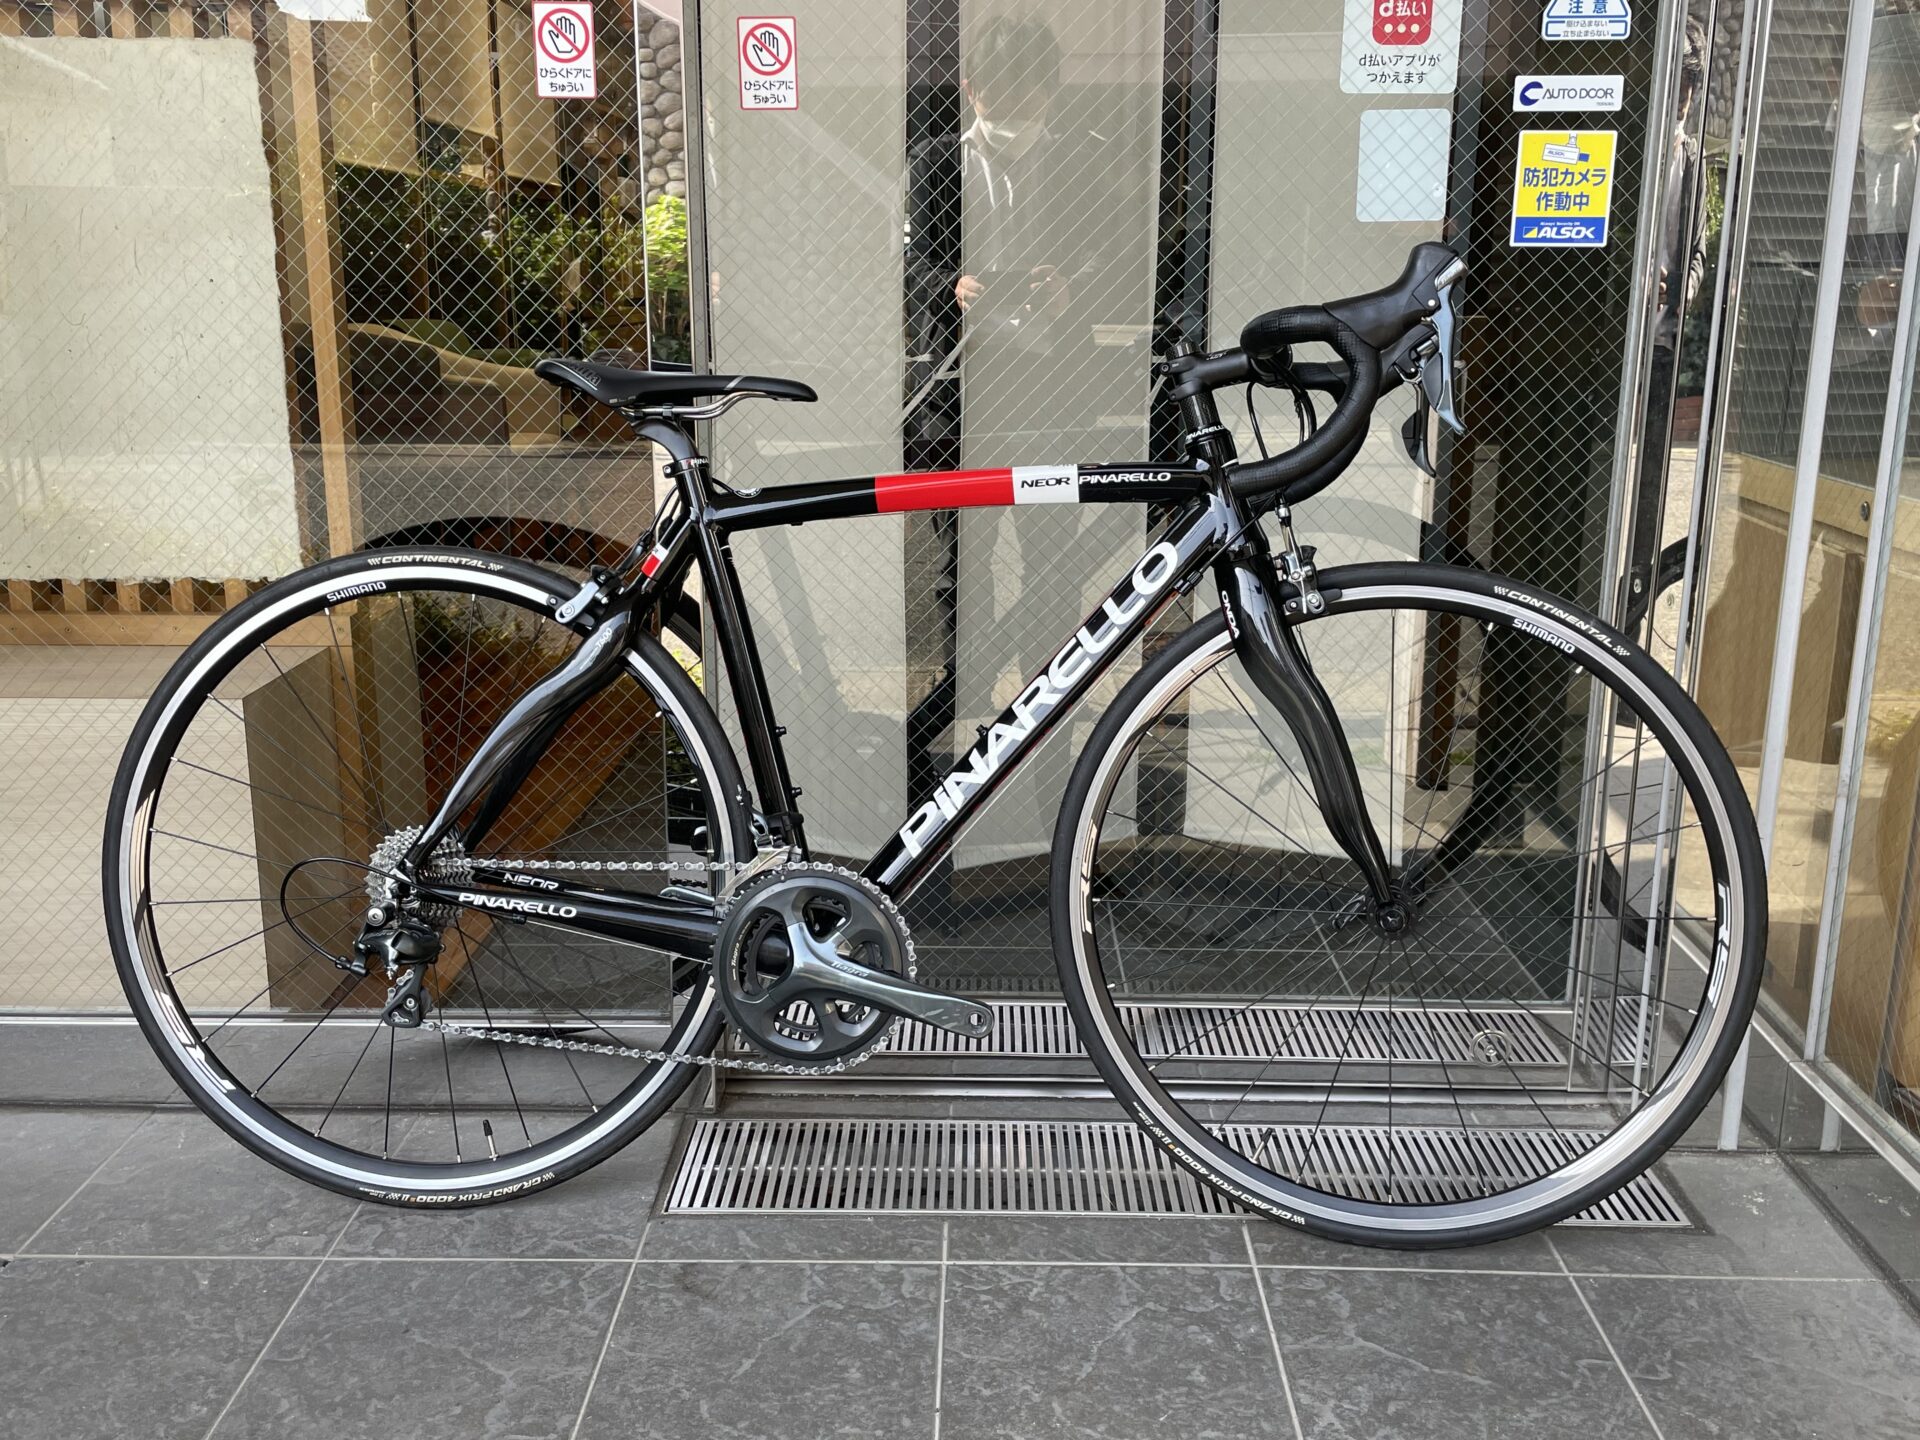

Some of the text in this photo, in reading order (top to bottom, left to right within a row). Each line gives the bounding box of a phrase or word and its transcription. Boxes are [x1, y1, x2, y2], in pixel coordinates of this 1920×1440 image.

[1379, 0, 1426, 17] d払い
[1568, 0, 1608, 14] 注意
[1358, 53, 1441, 67] d払いアプリが
[539, 67, 592, 79] ひらくドアに
[1366, 71, 1427, 84] つかえます
[549, 82, 584, 92] ちゅうい
[743, 80, 794, 91] ひらくドアに
[753, 94, 787, 104] ちゅうい
[1542, 88, 1577, 99] AUTO
[1523, 167, 1606, 187] 防犯カメラ
[1536, 191, 1589, 211] 作動中
[1538, 226, 1596, 239] ALSOK
[1021, 477, 1071, 488] NEOR
[1079, 472, 1171, 485] PINARELLO
[381, 554, 487, 569] CONTINENTAL
[326, 581, 387, 602] SHIMANO
[1222, 590, 1240, 639] ONDA
[1507, 590, 1613, 648] CONTINENTAL
[1511, 618, 1576, 654] SHIMANO
[899, 541, 1179, 858] PINARELLO
[458, 892, 577, 918] PINARELLO
